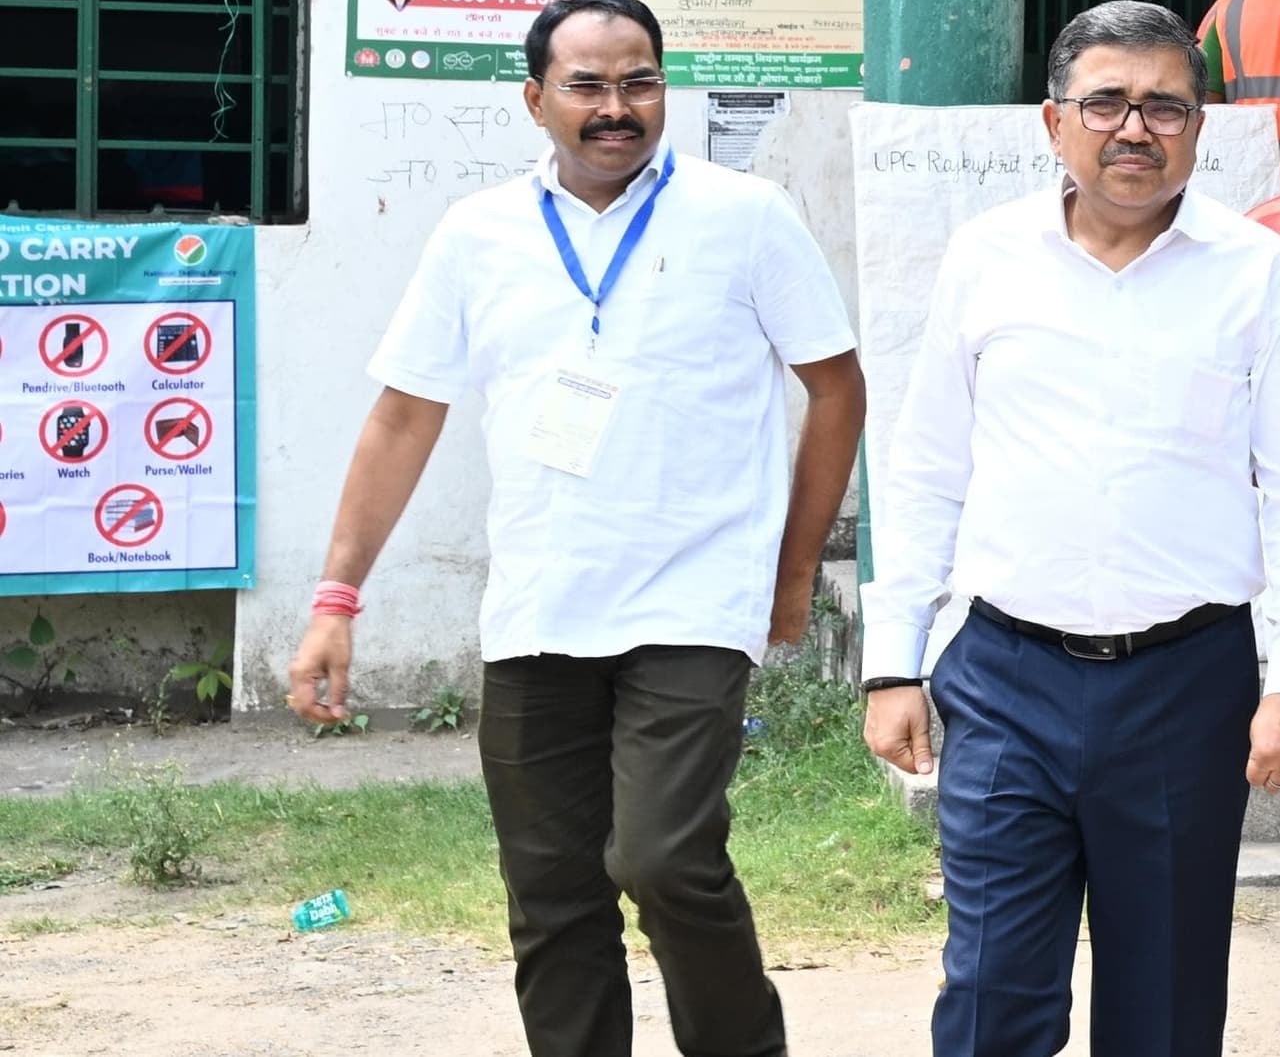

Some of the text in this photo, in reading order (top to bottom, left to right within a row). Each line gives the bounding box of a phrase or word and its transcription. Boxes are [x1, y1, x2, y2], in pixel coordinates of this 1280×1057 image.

[20, 236, 139, 261] CARRY
[22, 382, 125, 393] Pendrive/Bluetooth
[151, 379, 204, 390] Calculator
[57, 467, 91, 478] Watch
[145, 464, 212, 476] Purse/Wallet
[88, 551, 171, 563] Book/Notebook
